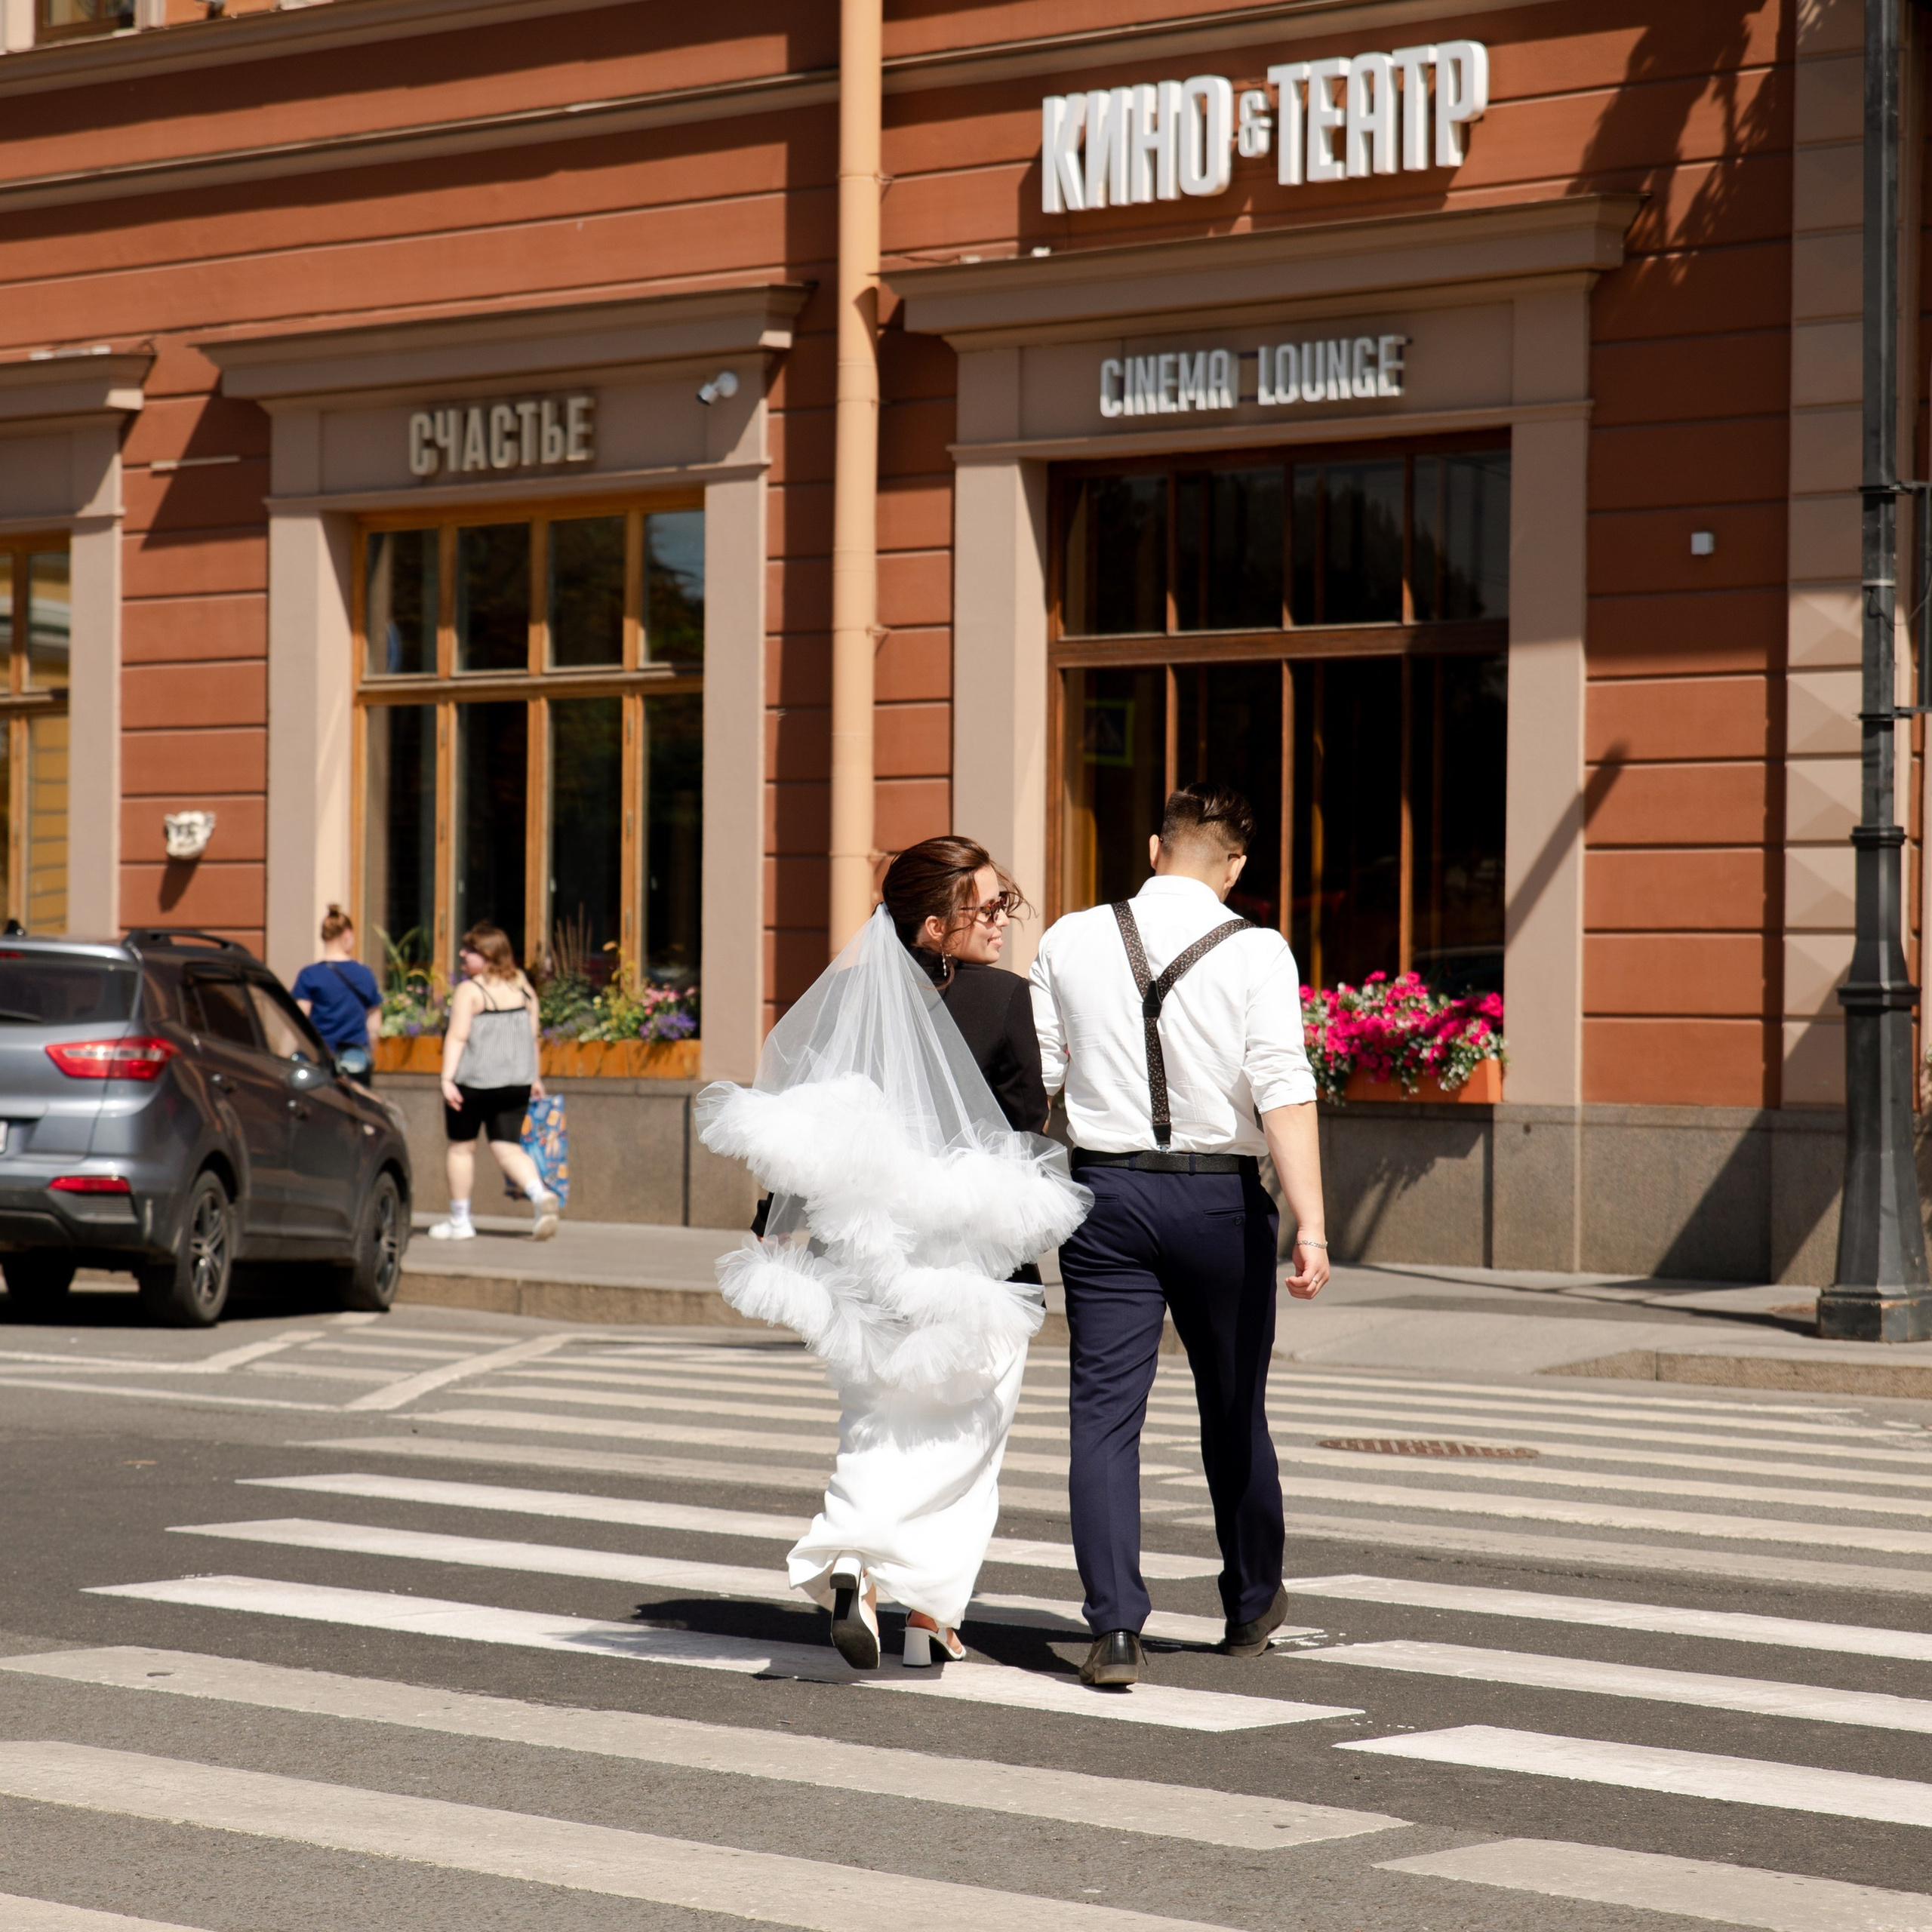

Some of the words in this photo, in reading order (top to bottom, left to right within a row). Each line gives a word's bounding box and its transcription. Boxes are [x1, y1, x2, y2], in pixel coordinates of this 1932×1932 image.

[1100, 349, 1238, 417] CINEMA
[1257, 334, 1407, 406] LOUNGE
[409, 395, 595, 475] СЧАСТЬЕ
